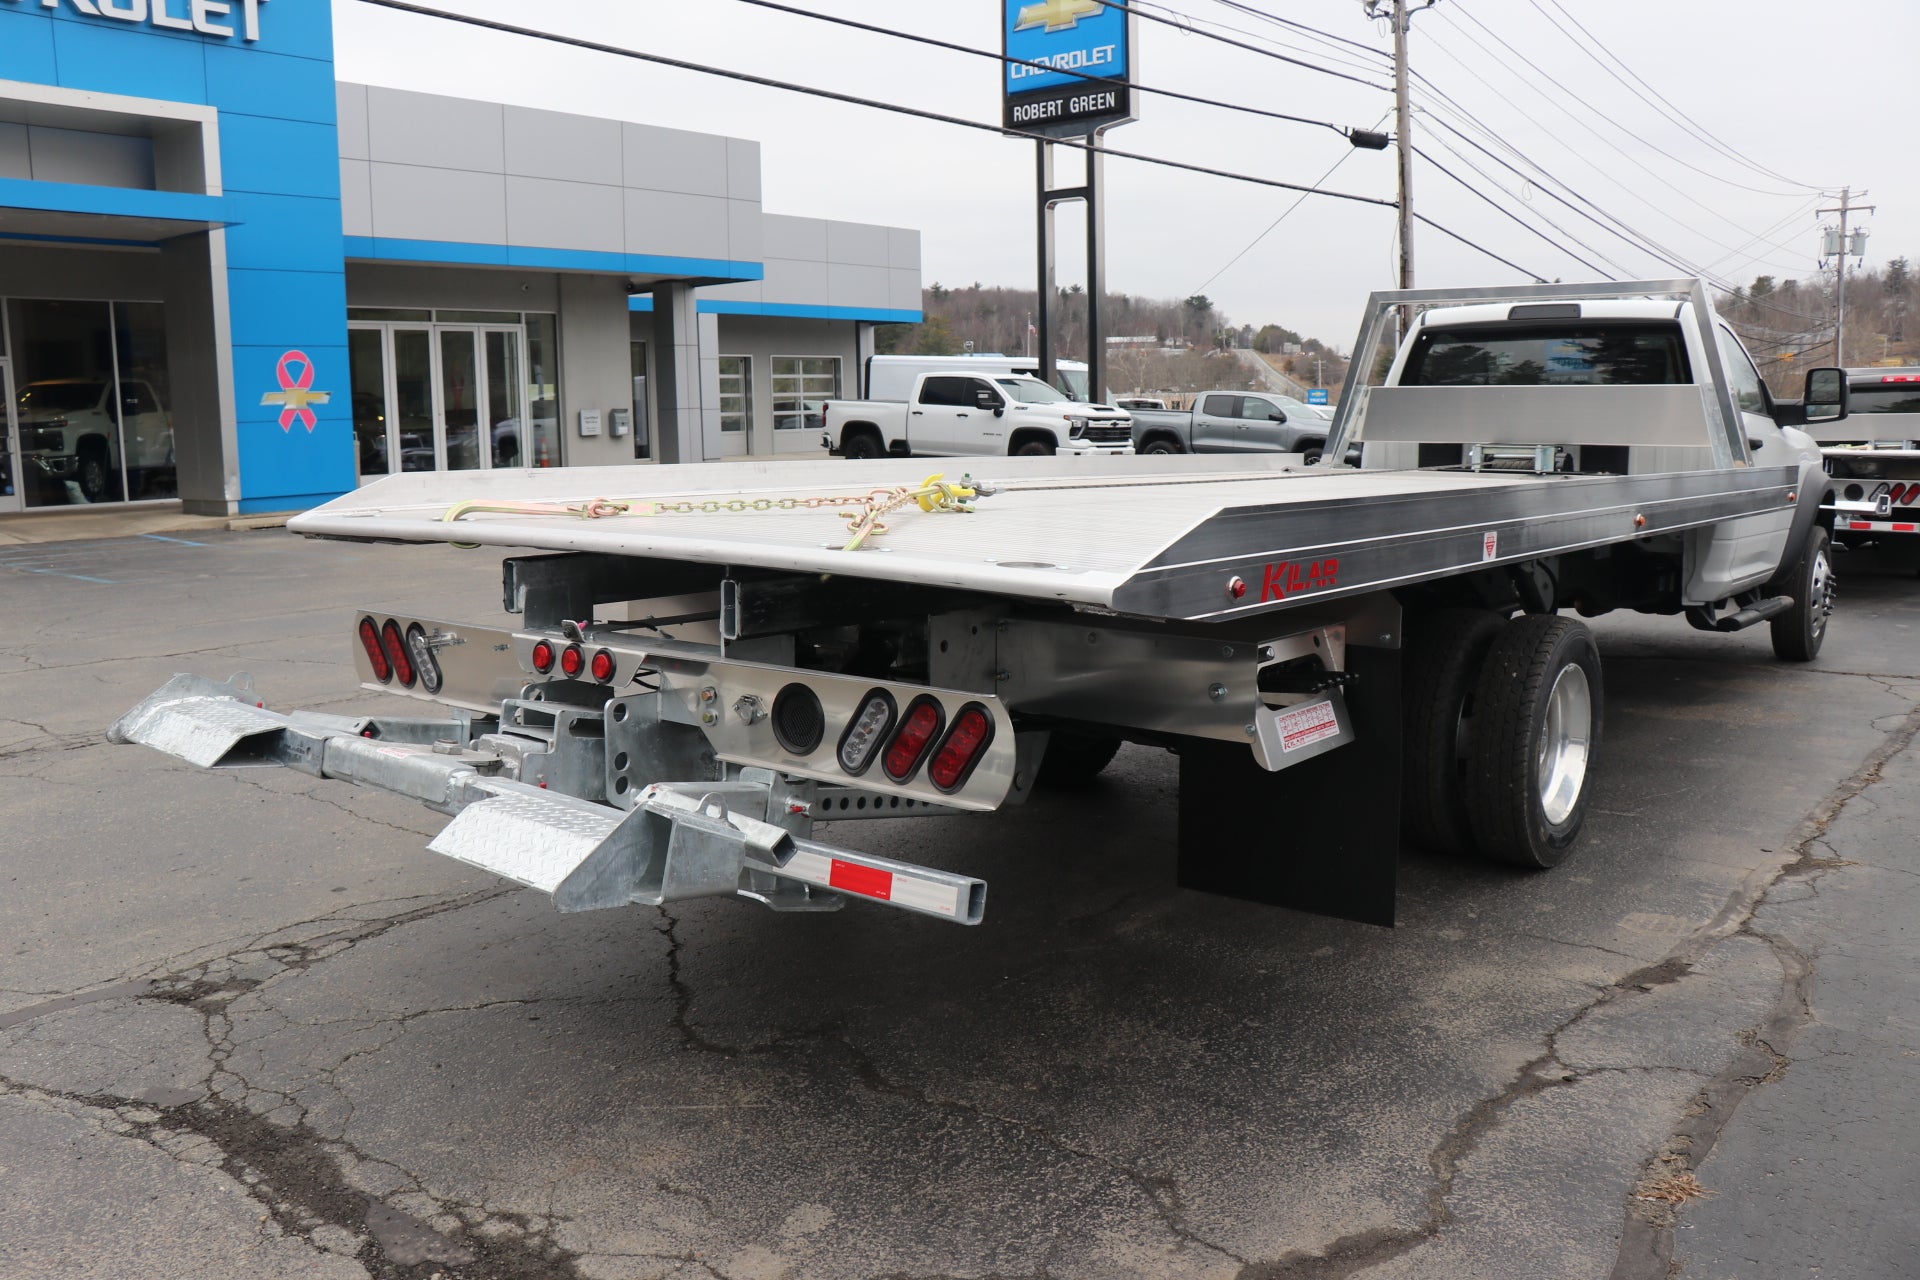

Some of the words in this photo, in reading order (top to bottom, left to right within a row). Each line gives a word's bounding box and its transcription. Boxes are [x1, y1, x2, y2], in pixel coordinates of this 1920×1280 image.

[1011, 44, 1116, 79] CHEVROLET
[1013, 99, 1063, 122] ROBERT
[1069, 91, 1115, 114] GREEN
[1260, 558, 1339, 603] KILAR
